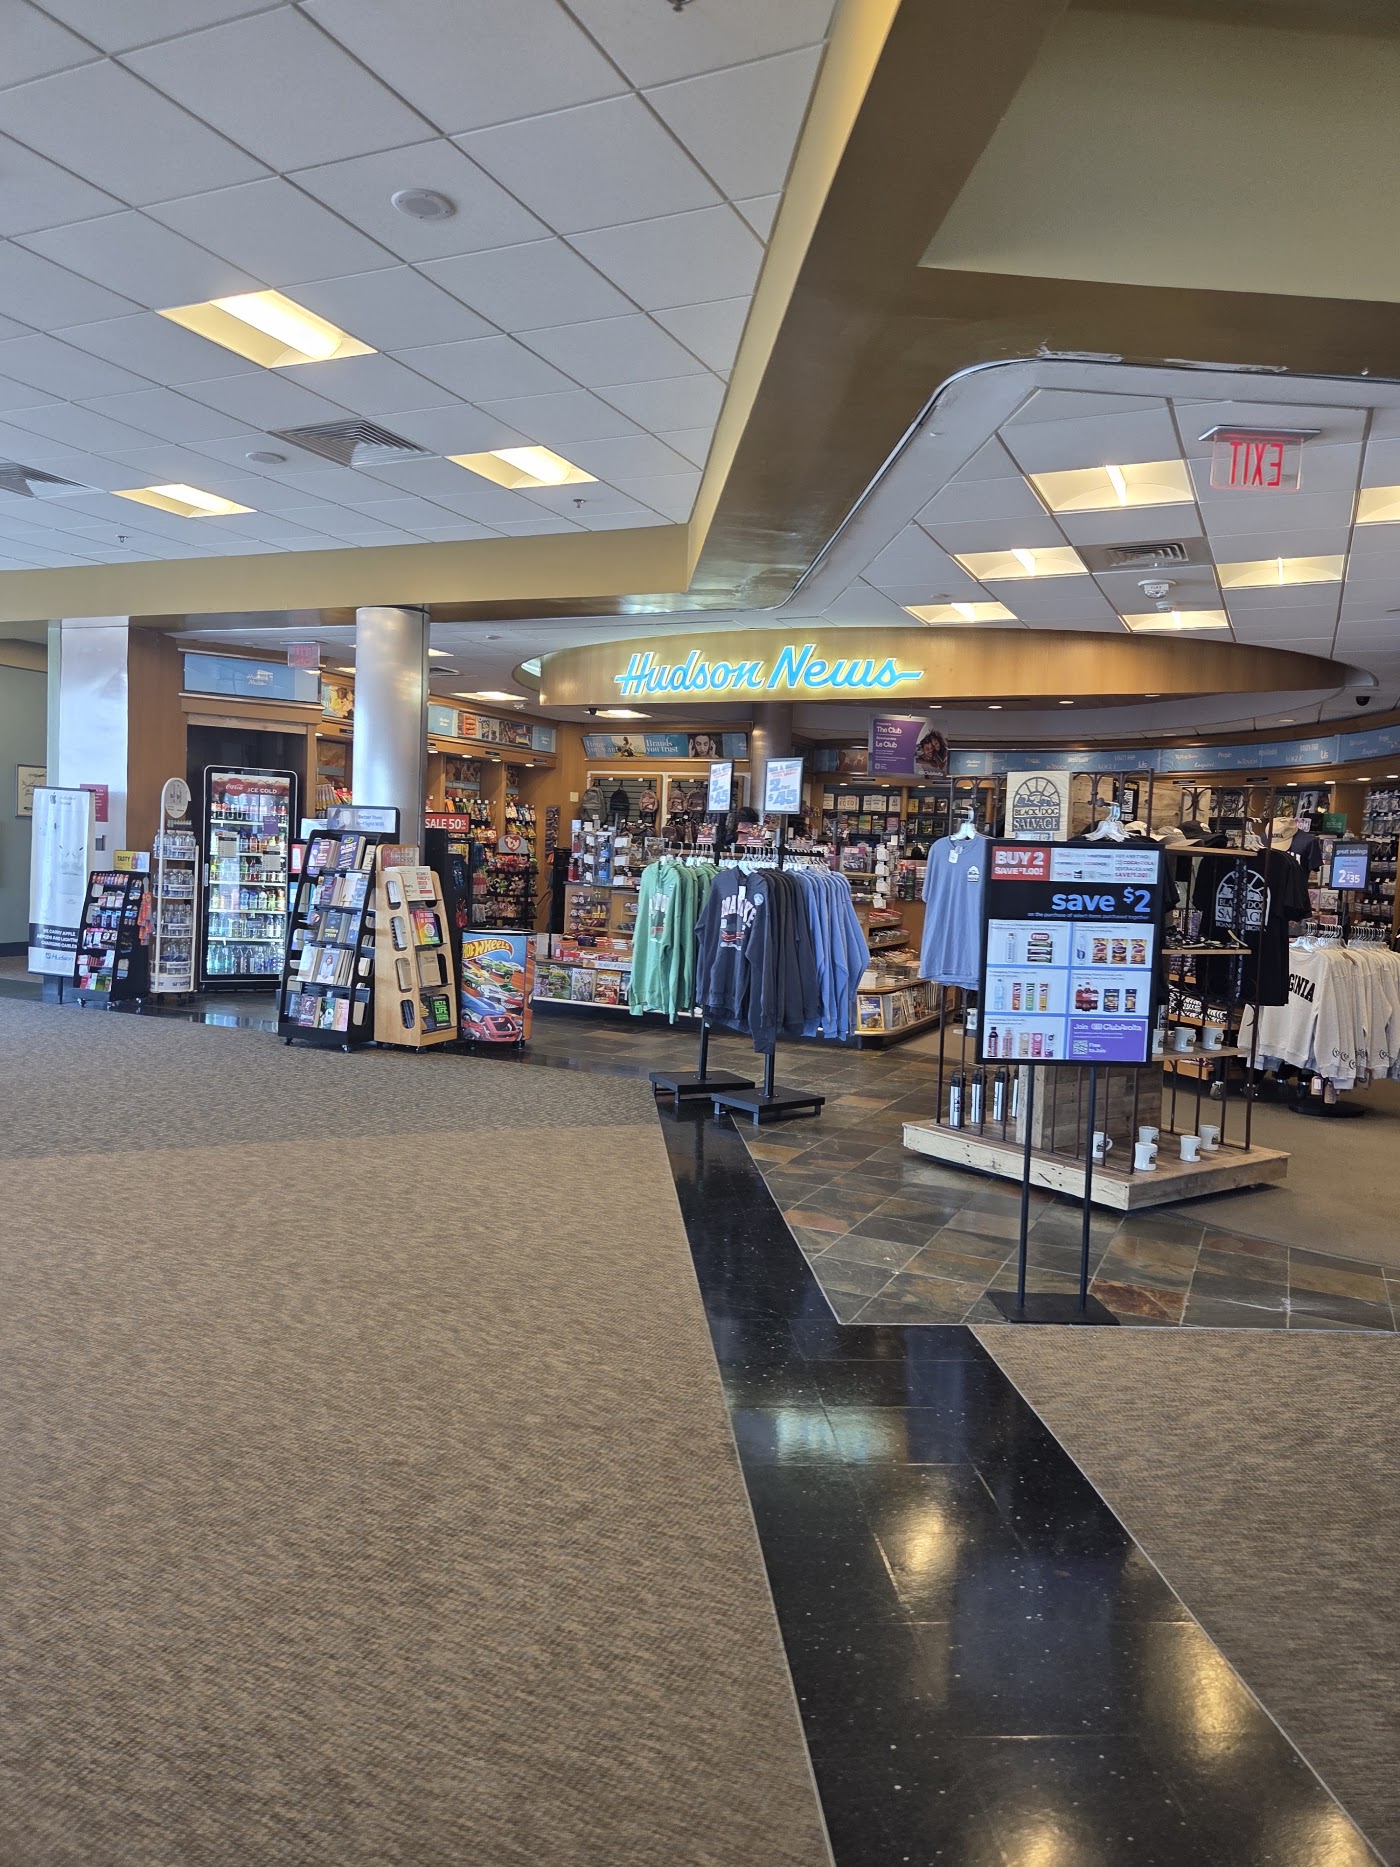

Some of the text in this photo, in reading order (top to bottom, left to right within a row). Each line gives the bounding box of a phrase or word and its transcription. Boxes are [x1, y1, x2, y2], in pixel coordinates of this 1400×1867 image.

[614, 643, 924, 695] Hudson News
[225, 783, 244, 791] Coca-Cola
[769, 778, 781, 792] 2
[768, 788, 798, 805] $45
[1014, 807, 1059, 816] BLACK DOG
[425, 818, 447, 829] SALE
[1013, 817, 1059, 830] SALVAGE
[505, 836, 520, 849] ty
[995, 850, 1044, 865] BUY 2
[1336, 848, 1368, 856] great savings
[1338, 869, 1360, 883] 2 $35
[1051, 886, 1151, 913] save $2
[1288, 973, 1316, 1003] GINIA
[1103, 1023, 1142, 1032] ClubAvolta
